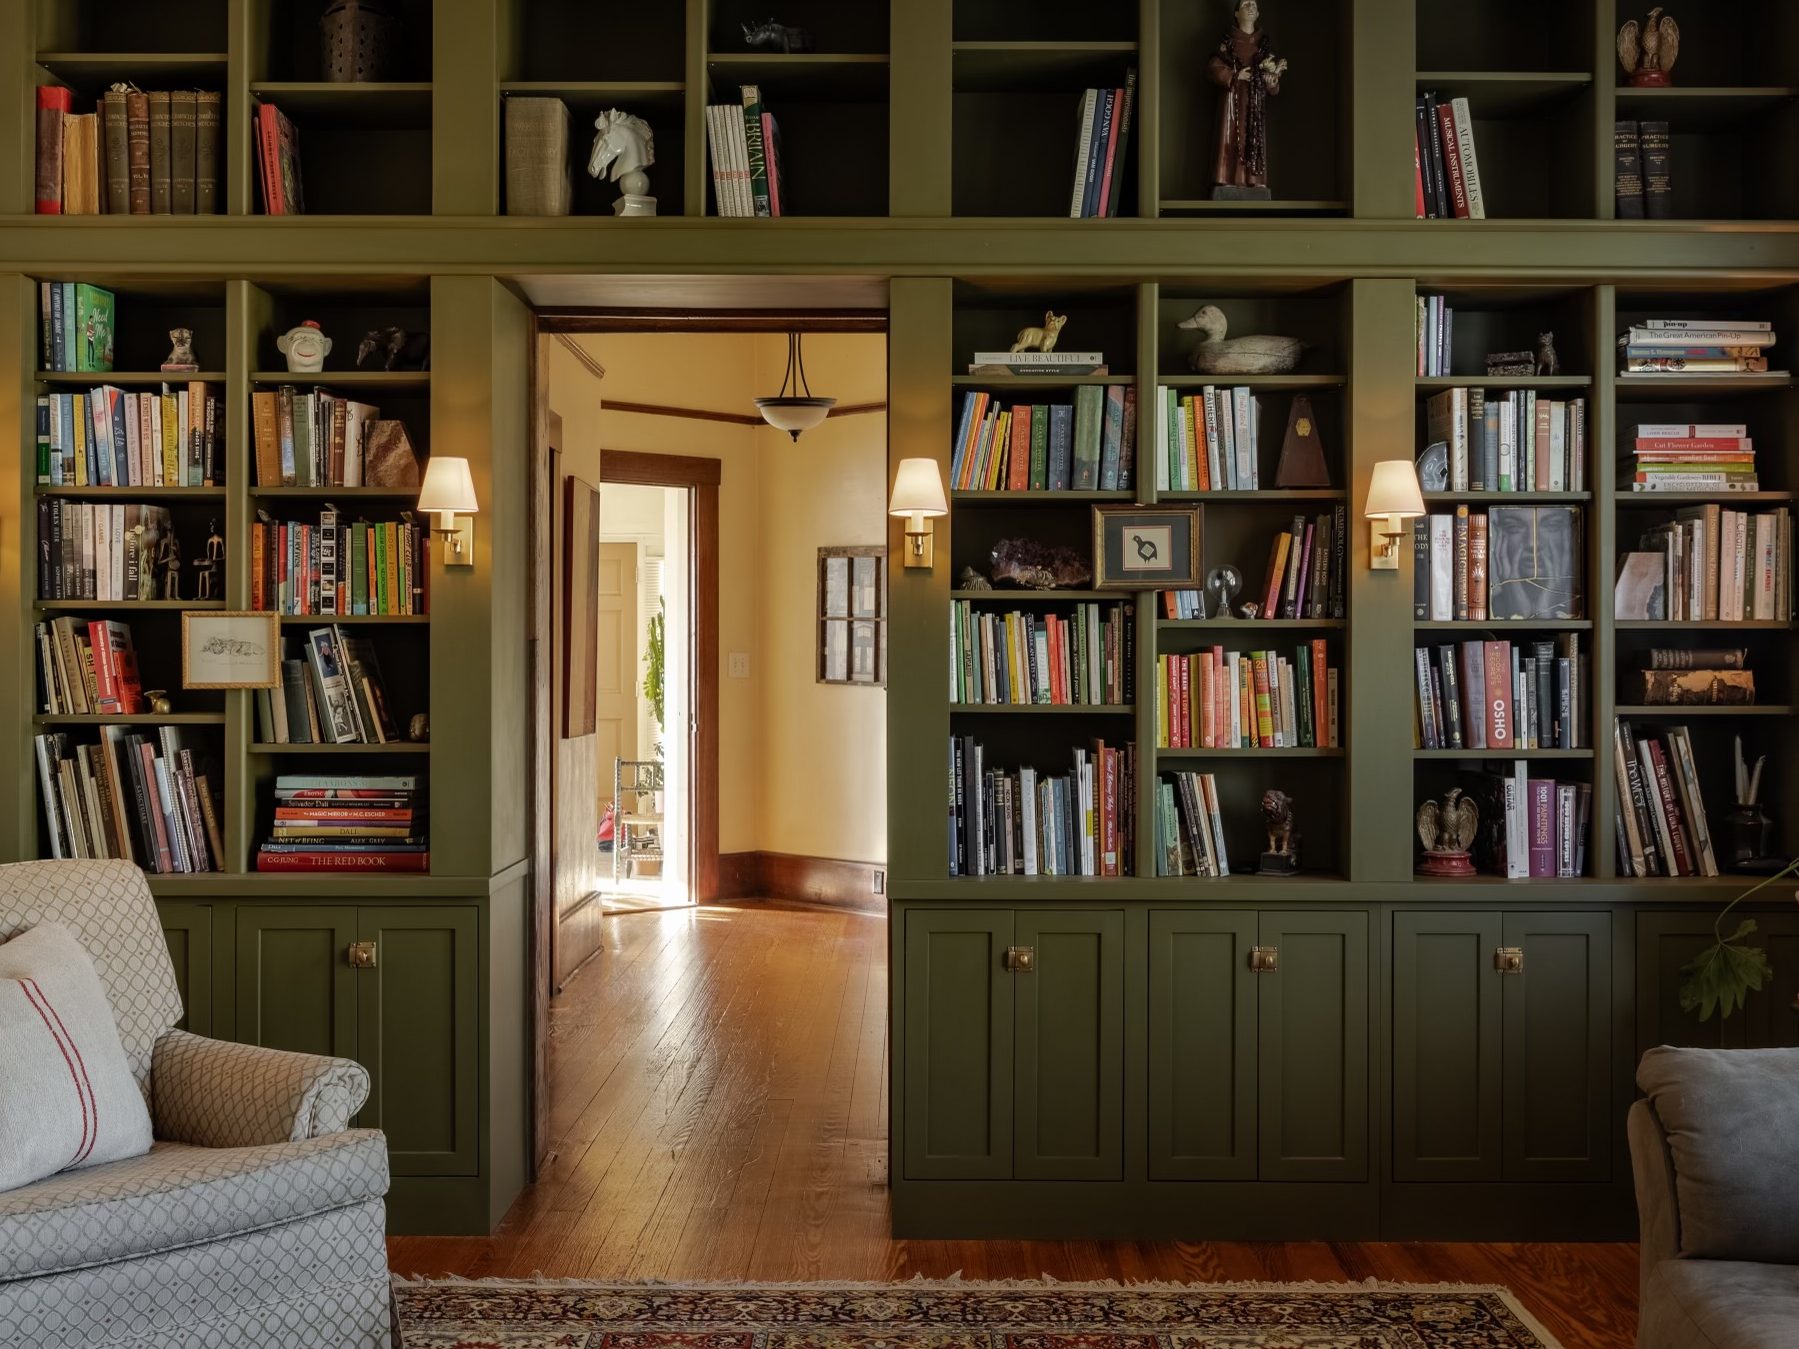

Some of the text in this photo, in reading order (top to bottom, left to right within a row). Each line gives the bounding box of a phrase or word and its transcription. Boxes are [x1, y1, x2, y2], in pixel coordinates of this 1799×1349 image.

[1101, 95, 1114, 137] VAN GOGH
[746, 123, 765, 180] BRITAIN
[1444, 117, 1466, 208] MUSICAL INSTRUMENTS
[1459, 126, 1478, 202] AUTOMOBILES
[92, 308, 109, 322] Need
[94, 324, 106, 338] Me
[1662, 320, 1688, 329] pin-up
[1650, 331, 1742, 341] The Great American Pin-Up
[1009, 353, 1028, 363] LIVE
[1654, 441, 1715, 449] Cut Flower Garden
[1336, 505, 1345, 557] NUMEROLOGY
[294, 530, 302, 568] SURVIVOR
[128, 566, 138, 581] fall
[1494, 699, 1507, 740] OSHO
[1506, 784, 1515, 812] GUITAR
[1627, 760, 1646, 808] The WEST
[1660, 777, 1671, 802] HISTORY
[135, 785, 148, 825] SANCTUARY
[1540, 804, 1548, 844] PAINTINGS
[311, 856, 387, 866] THE RED BOOK
